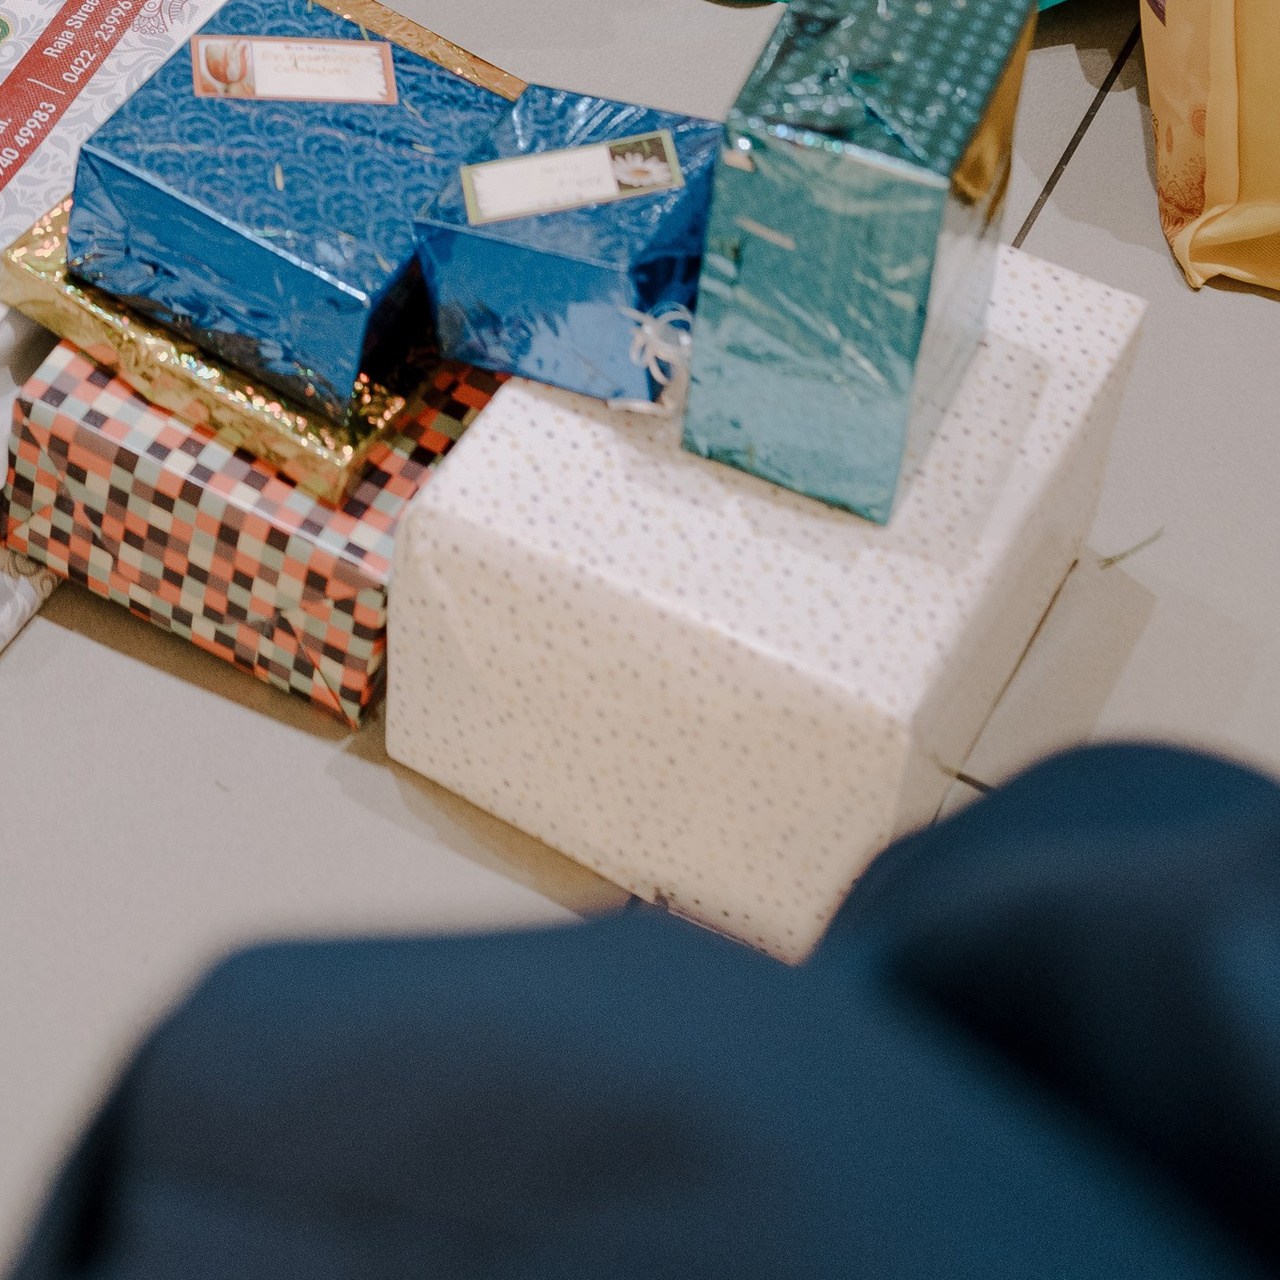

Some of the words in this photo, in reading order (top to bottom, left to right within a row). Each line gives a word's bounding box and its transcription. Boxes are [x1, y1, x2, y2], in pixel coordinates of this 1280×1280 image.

[42, 30, 76, 59] Raja
[62, 49, 97, 83] 0422
[13, 101, 57, 148] 49983
